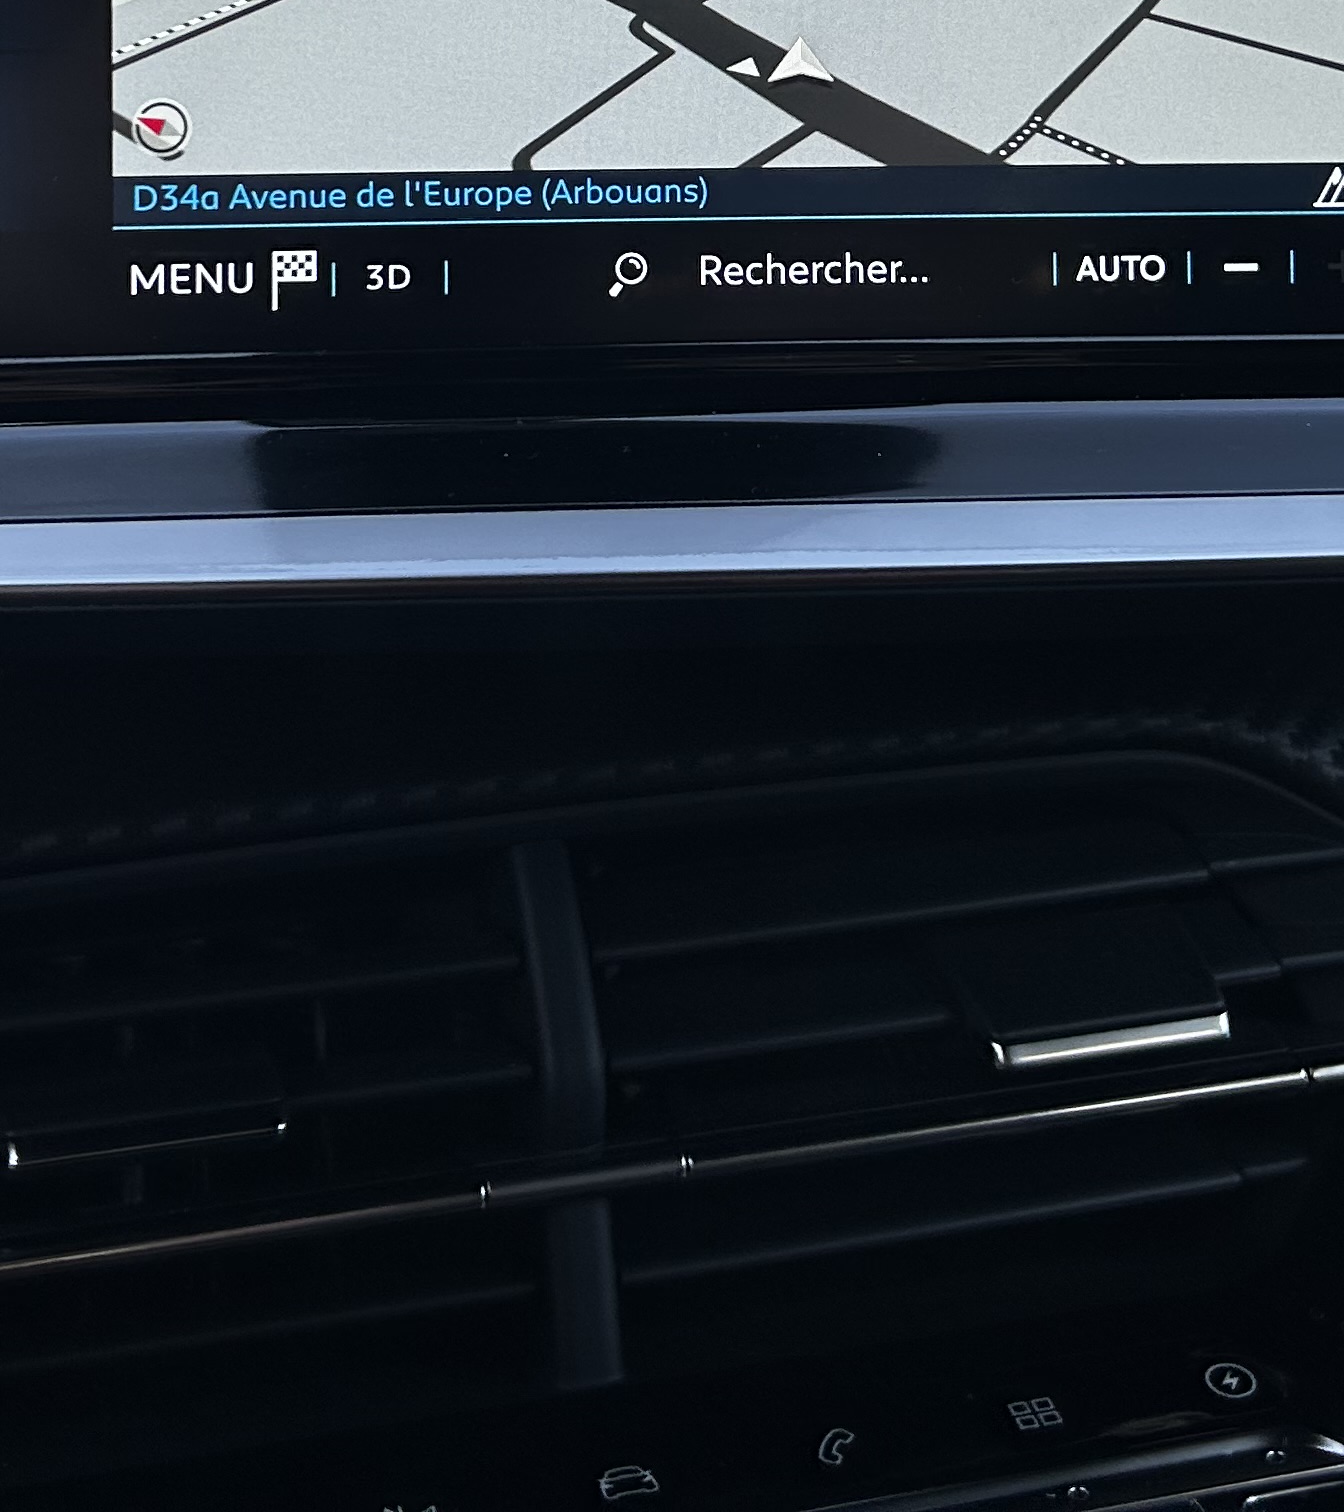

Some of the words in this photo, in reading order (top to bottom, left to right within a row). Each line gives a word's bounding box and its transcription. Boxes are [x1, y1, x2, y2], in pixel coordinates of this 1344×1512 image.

[132, 184, 220, 213] D34a
[228, 183, 348, 211] Avenue
[355, 179, 396, 209] de
[404, 178, 533, 213] l'Europe
[541, 174, 709, 212] (Arbouans)
[130, 261, 255, 297] MENU
[365, 264, 412, 292] 3D
[699, 251, 930, 287] Rechercher...
[1074, 254, 1167, 283] AUTO
